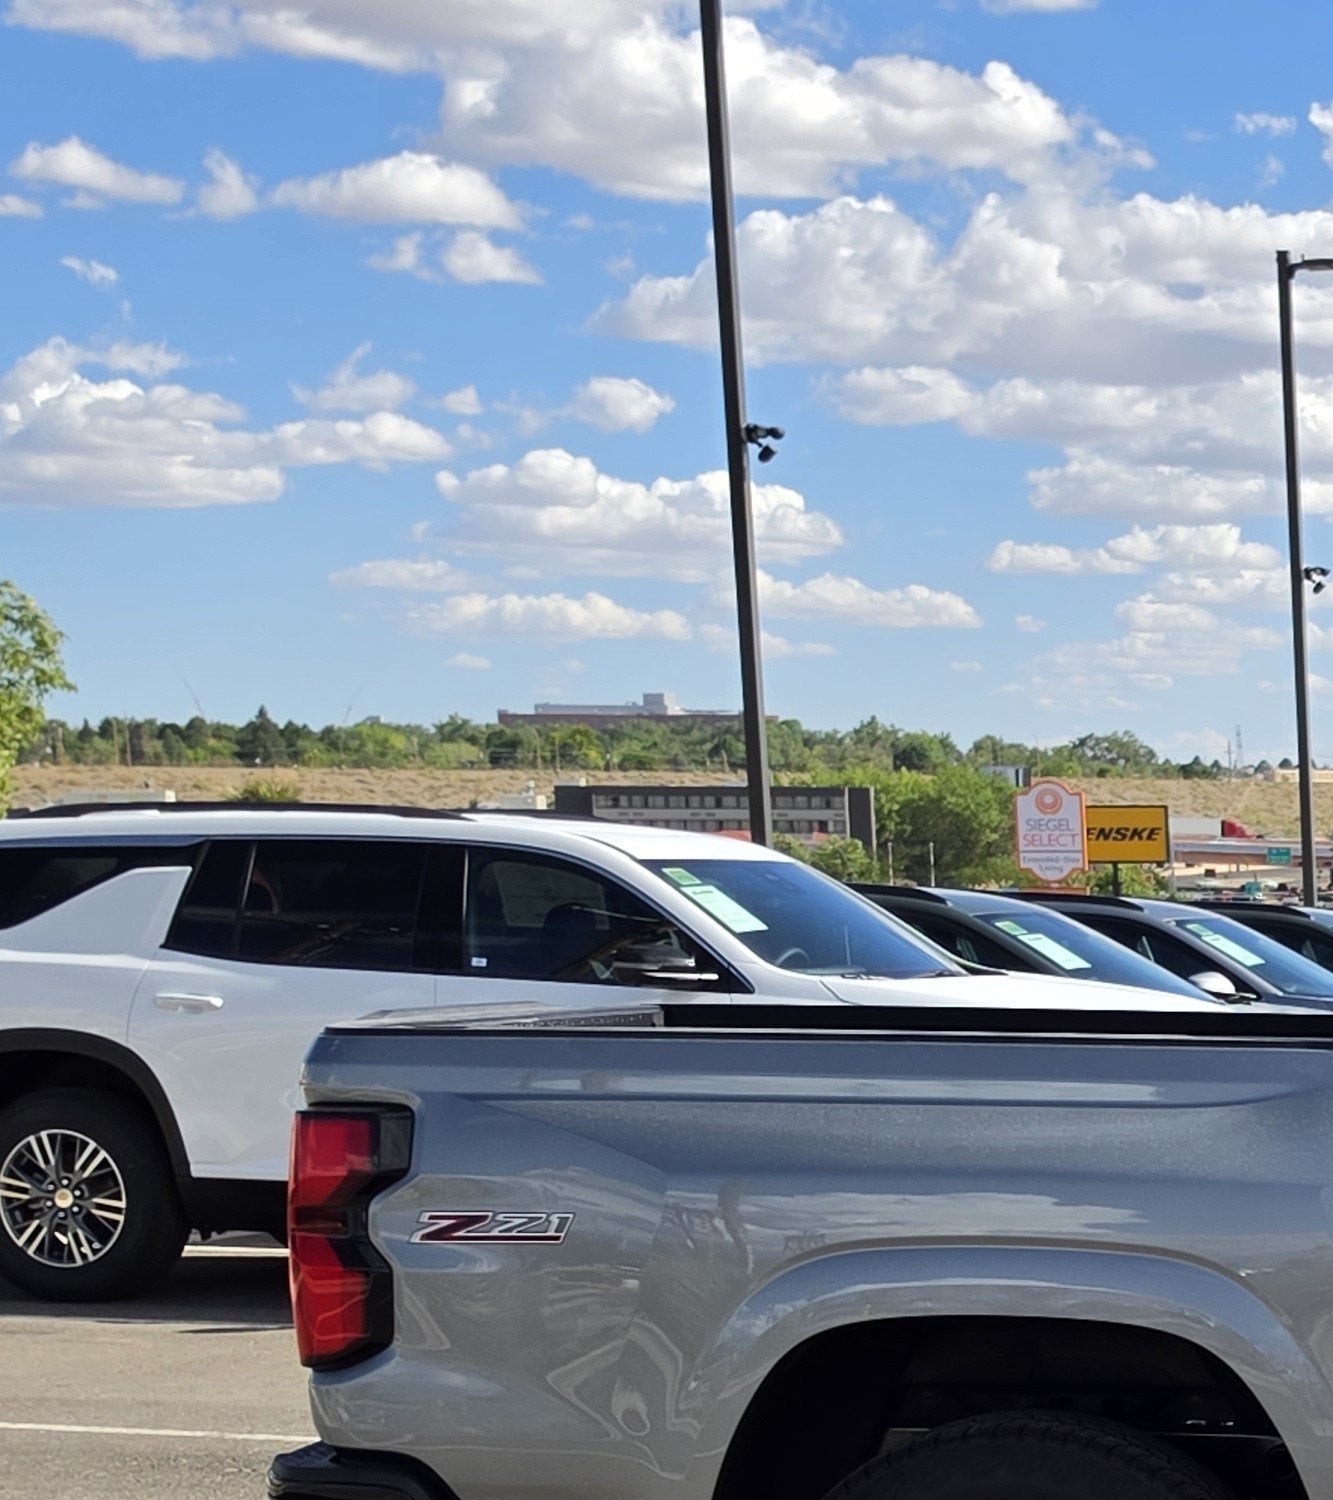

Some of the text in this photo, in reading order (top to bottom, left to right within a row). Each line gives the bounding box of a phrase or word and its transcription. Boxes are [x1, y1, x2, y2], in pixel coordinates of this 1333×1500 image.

[1025, 818, 1074, 832] SIEGEL
[1022, 833, 1079, 847] SELECT
[1086, 827, 1162, 841] ENSKE
[408, 1211, 574, 1244] Z71
